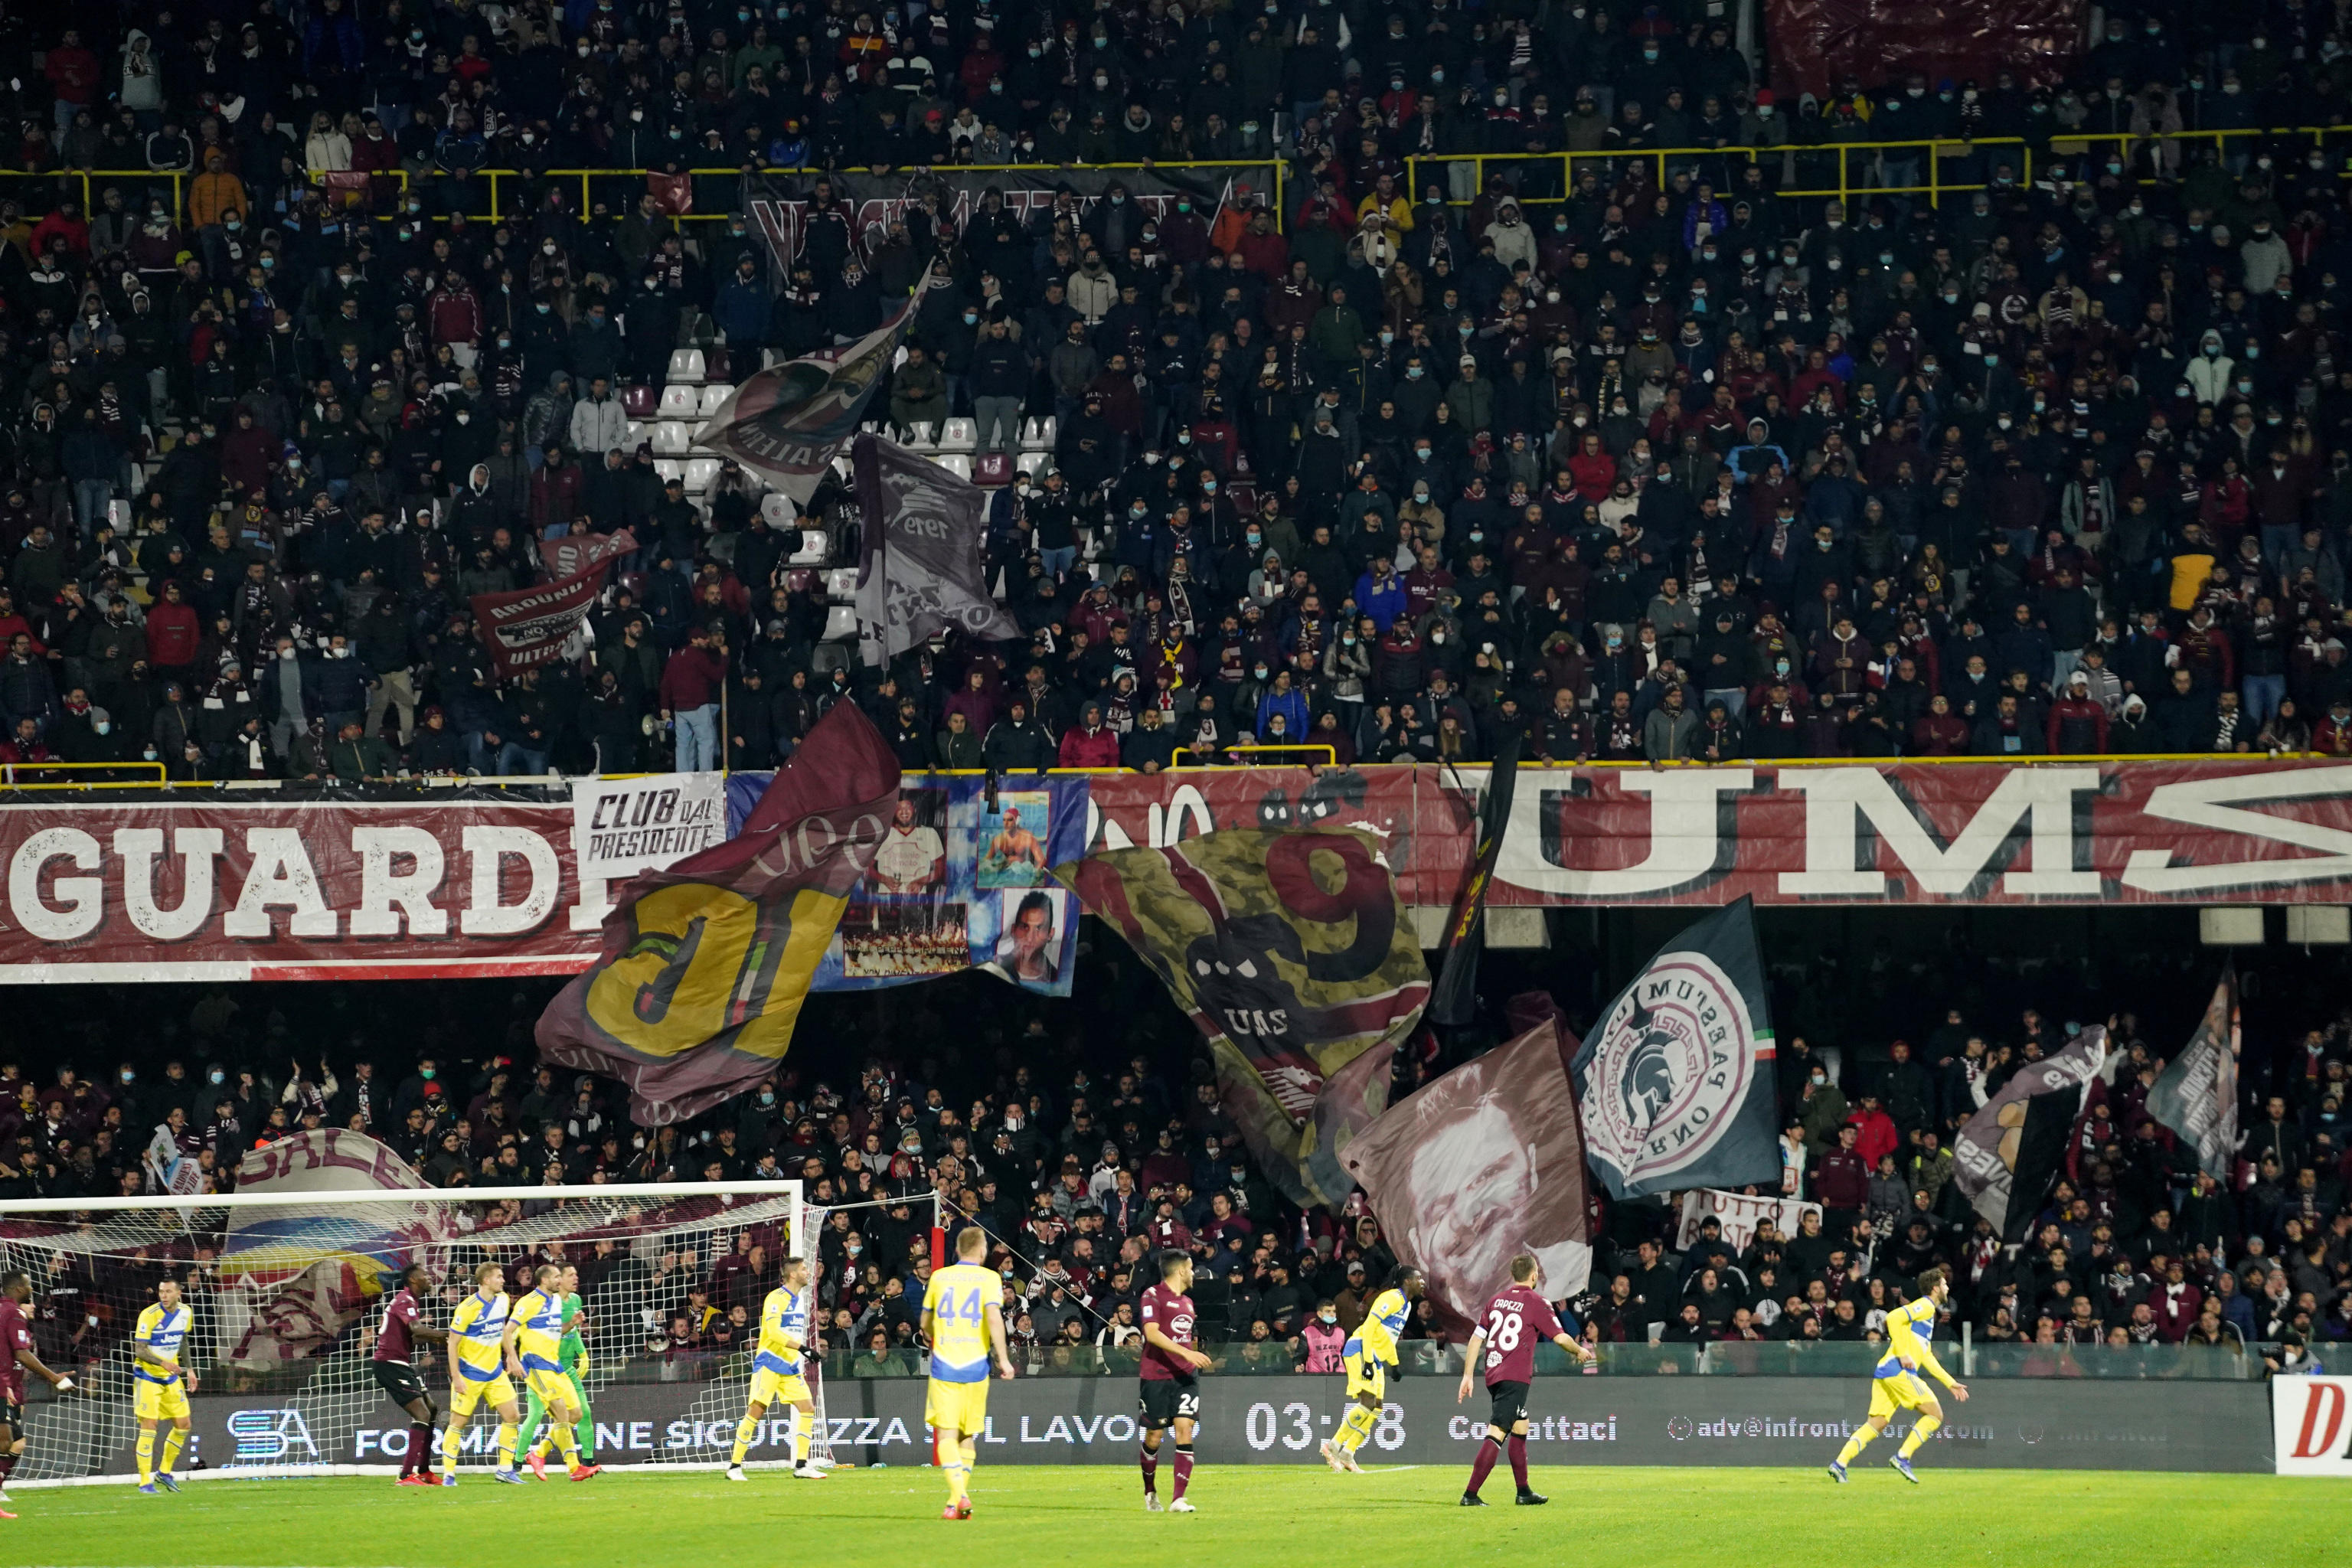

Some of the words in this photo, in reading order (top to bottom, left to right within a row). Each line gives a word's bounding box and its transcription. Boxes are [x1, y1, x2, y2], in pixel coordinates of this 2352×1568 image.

[590, 787, 681, 830] CLUB
[679, 798, 712, 825] DAL
[587, 824, 714, 863] PRESIDENTE
[1697, 1188, 1784, 1221] TUTTO
[937, 1286, 983, 1328] 44
[1494, 1298, 1524, 1312] CAPEZZI
[1485, 1309, 1523, 1351] 28
[1178, 1393, 1200, 1413] 24
[2290, 1382, 2352, 1459] D
[1245, 1403, 1406, 1451] 03:8
[1448, 1413, 1617, 1440] Coattaci
